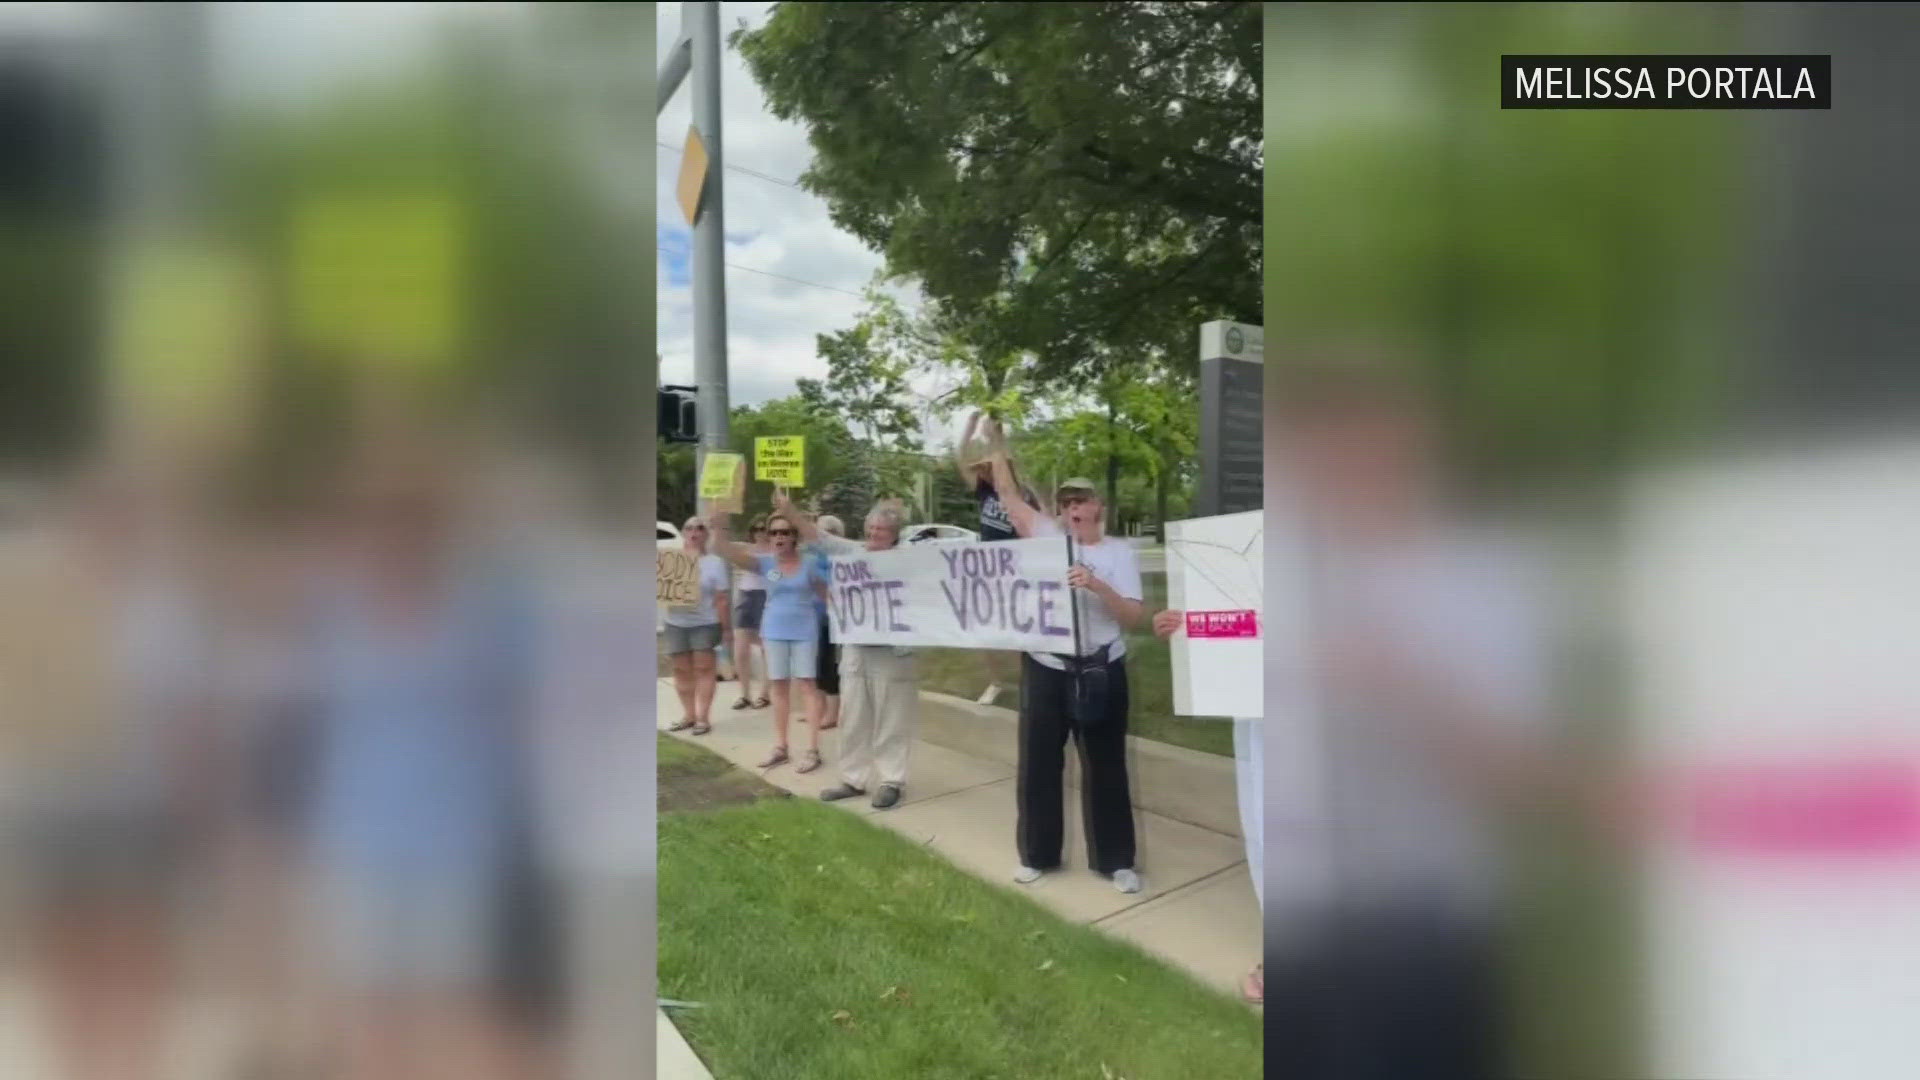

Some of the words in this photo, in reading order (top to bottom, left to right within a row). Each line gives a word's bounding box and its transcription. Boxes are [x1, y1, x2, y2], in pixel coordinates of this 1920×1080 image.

[767, 439, 791, 448] STOP
[830, 559, 873, 584] OUR
[940, 547, 1015, 580] YOUR
[828, 581, 911, 634] VOTE
[940, 575, 1071, 636] VOICE
